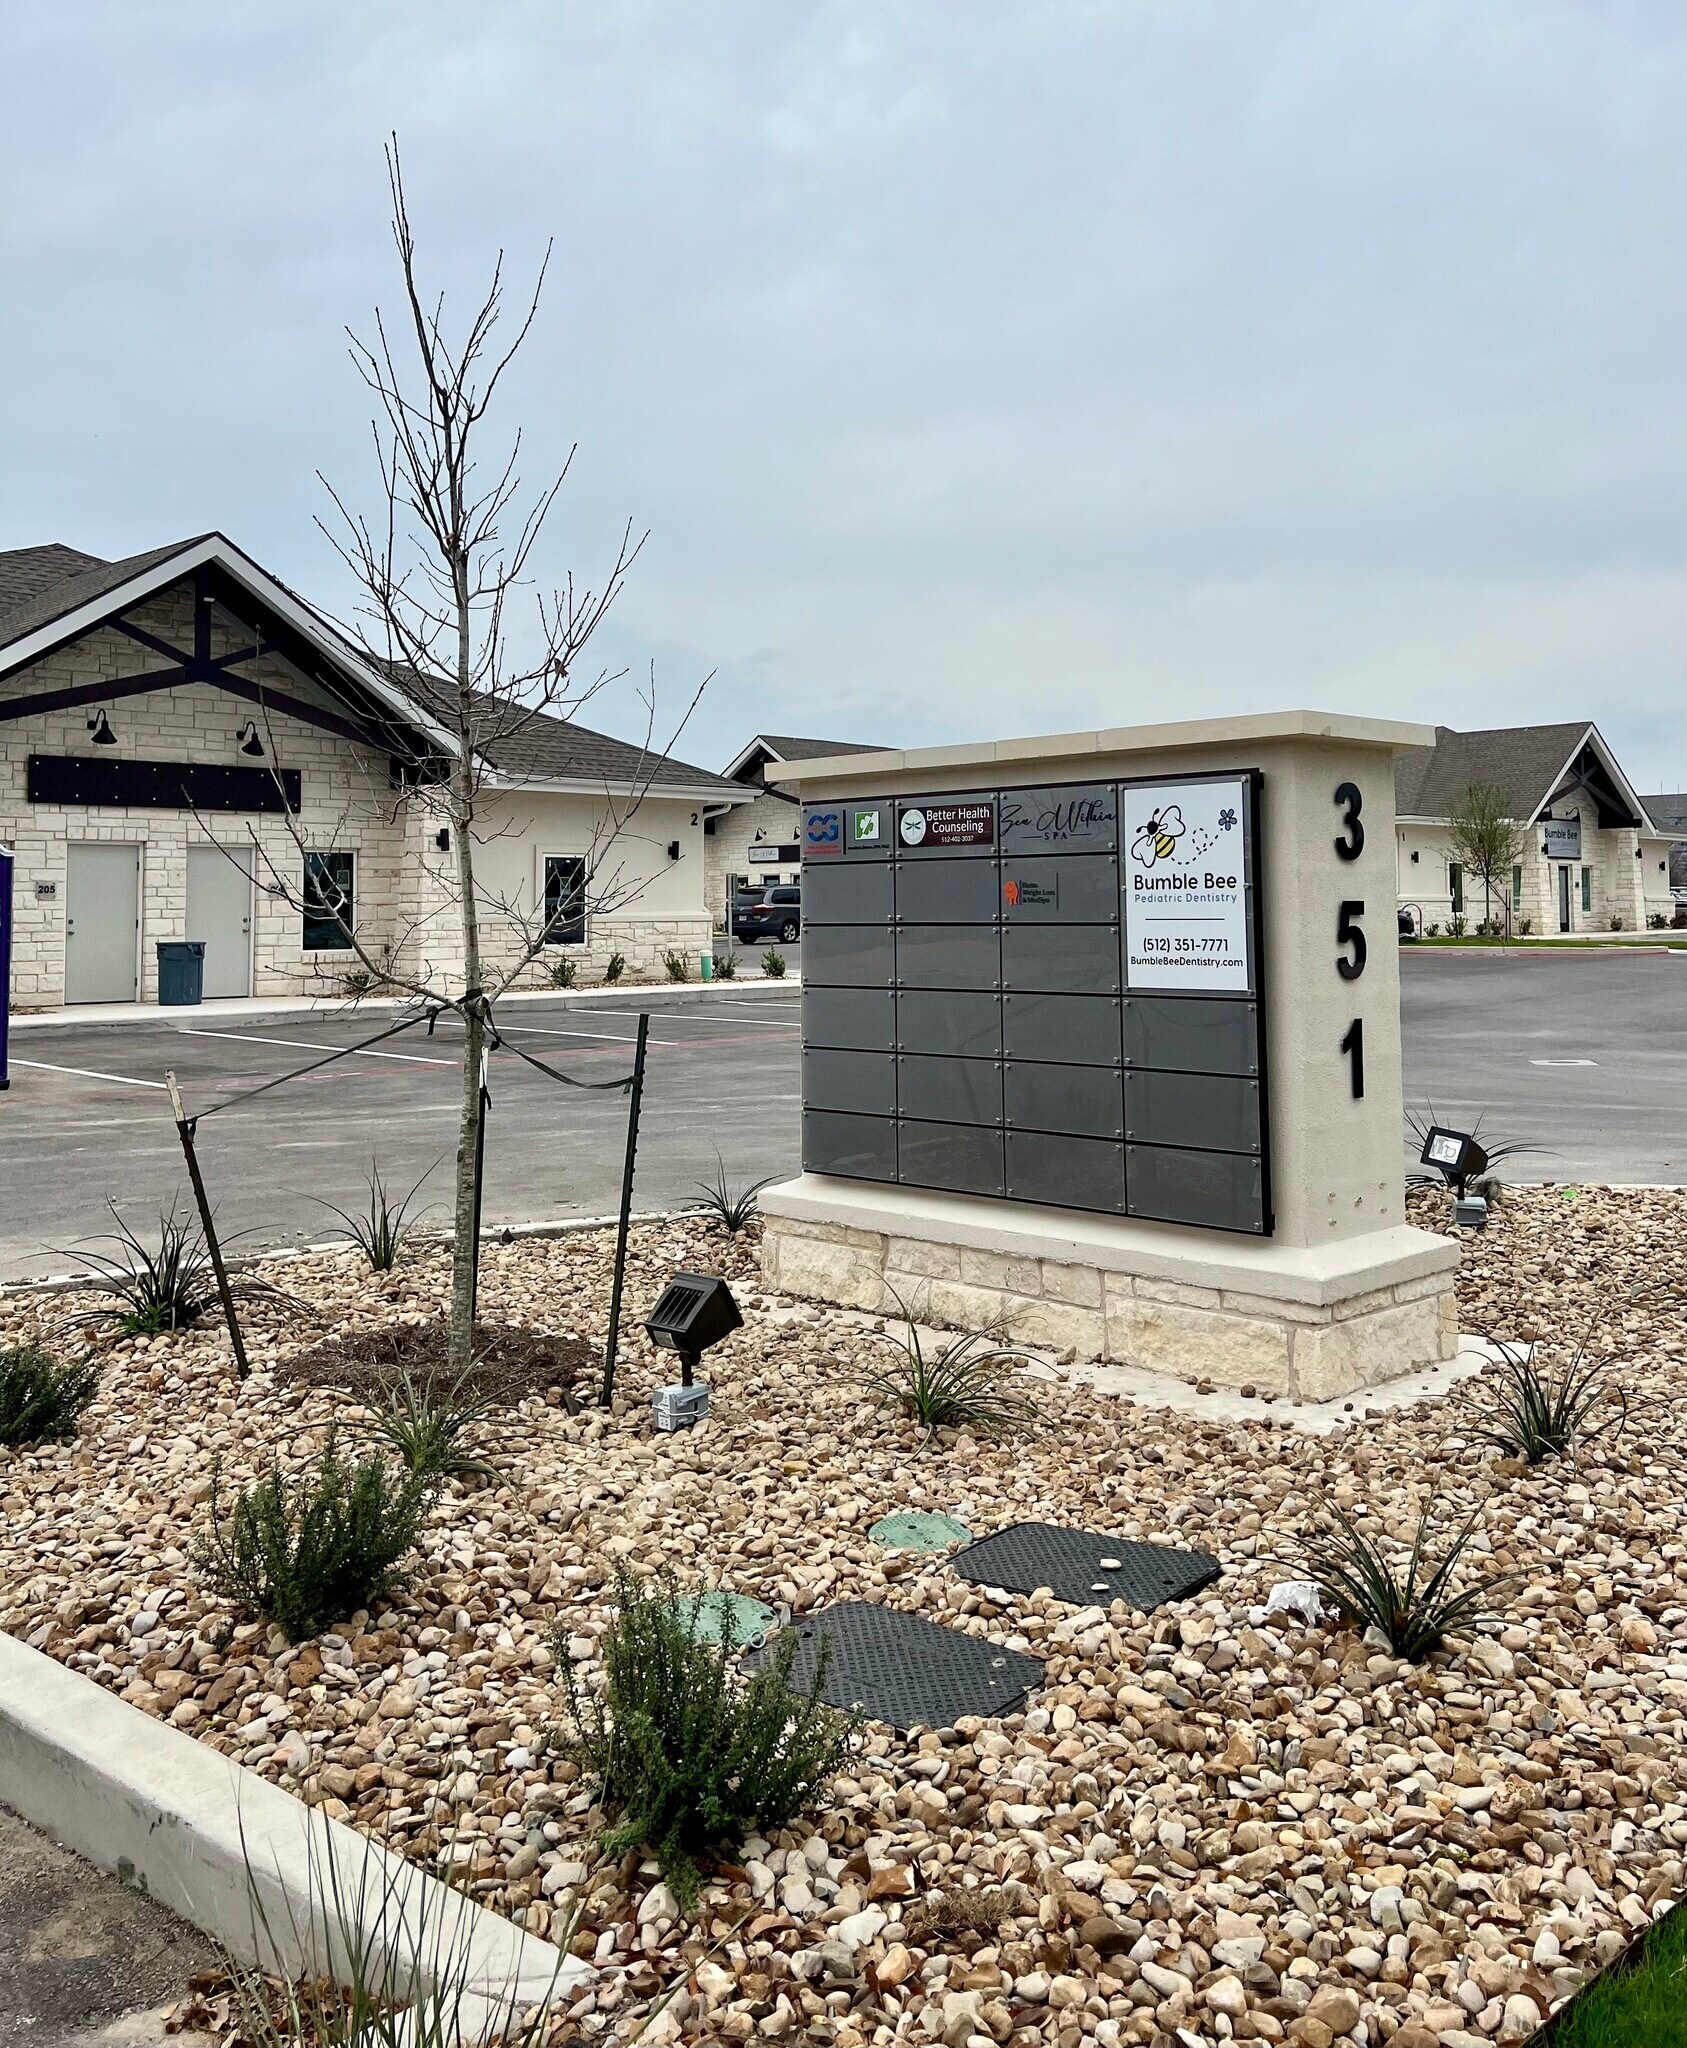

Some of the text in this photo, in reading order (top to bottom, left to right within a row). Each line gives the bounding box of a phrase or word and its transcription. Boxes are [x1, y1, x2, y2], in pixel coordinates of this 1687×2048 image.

[690, 812, 699, 826] 2
[926, 806, 990, 821] Better Health
[931, 819, 984, 834] Counseling
[1044, 832, 1068, 840] SPA
[1545, 828, 1578, 840] Bumble Bee
[1134, 872, 1237, 890] Bumble Bee
[38, 885, 56, 894] 205
[1134, 893, 1238, 904] Pediatric Dentistry
[1143, 937, 1229, 953] (512) 351-7771
[1131, 956, 1243, 968] BumbleBeeDentistry.com
